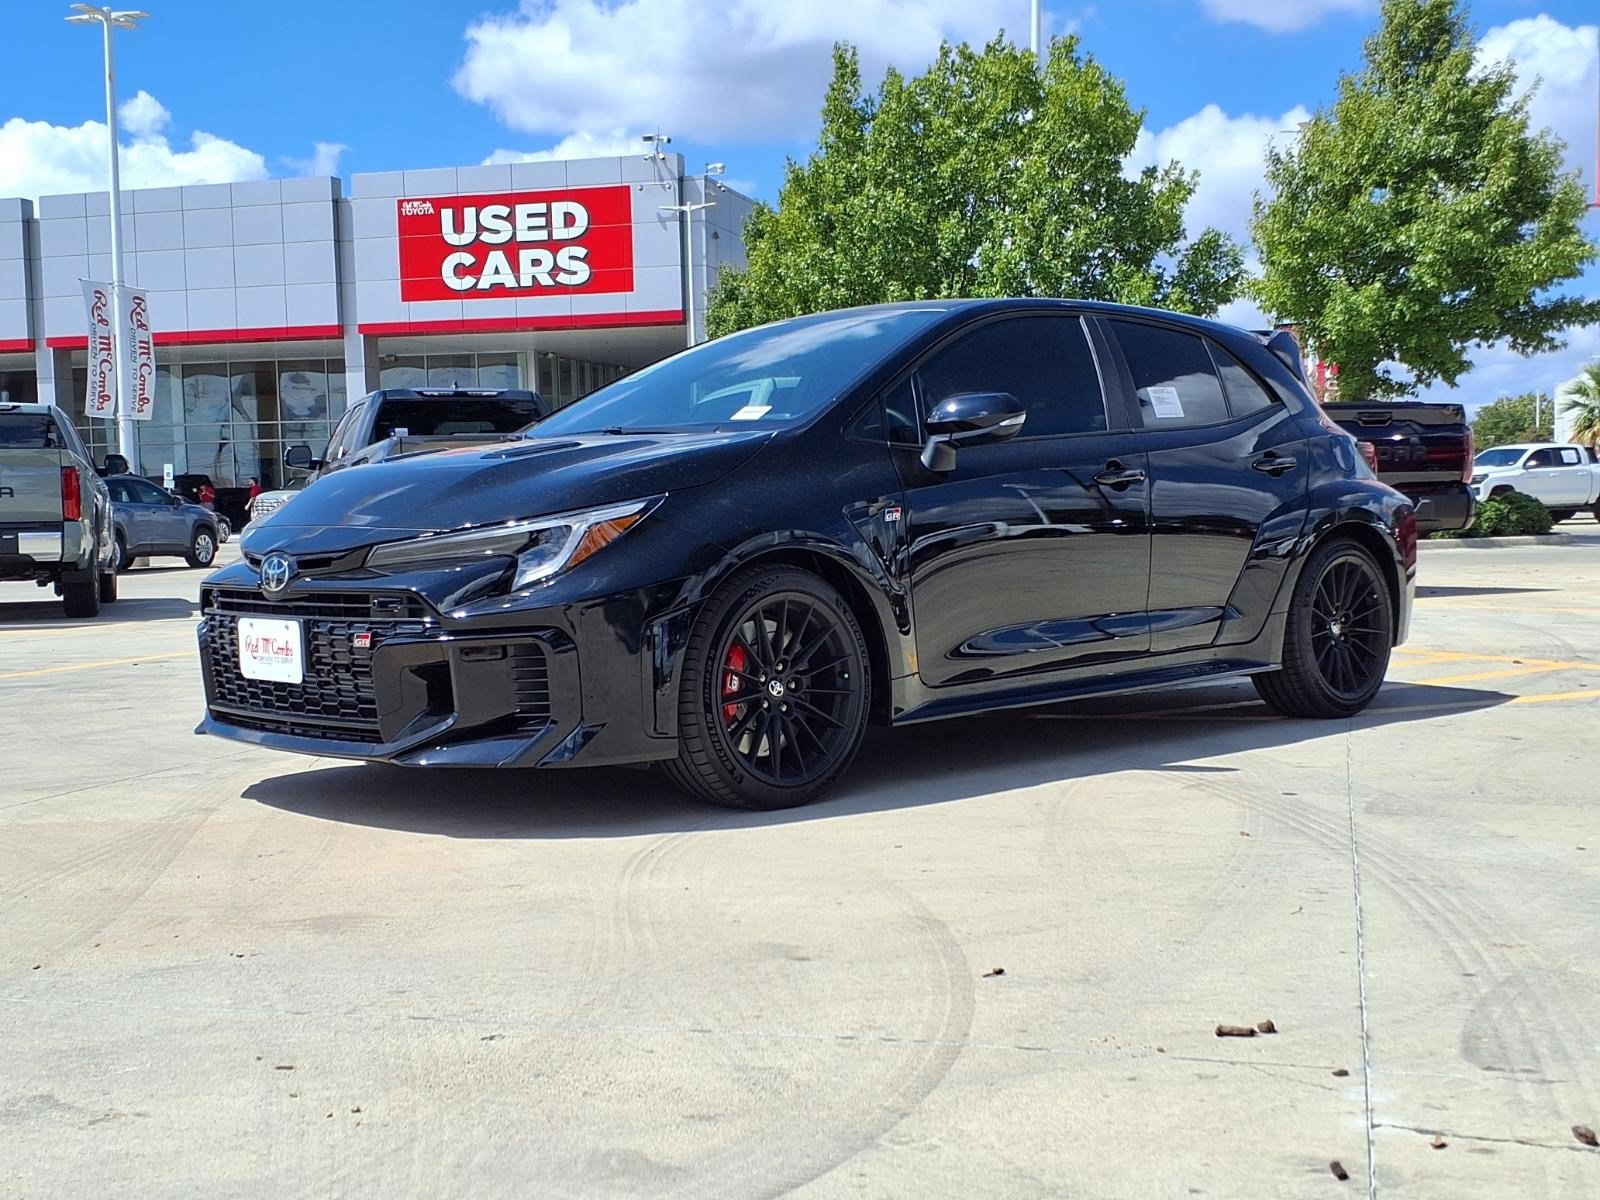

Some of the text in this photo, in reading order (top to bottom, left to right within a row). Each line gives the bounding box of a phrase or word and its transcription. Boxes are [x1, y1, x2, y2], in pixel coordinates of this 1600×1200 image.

[400, 207, 435, 216] TOYOTA
[440, 201, 589, 247] USED
[441, 246, 591, 291] CARS
[91, 289, 113, 412] Red McCombs
[130, 295, 152, 414] Red McCombs
[91, 364, 98, 377] TO
[131, 367, 138, 380] TO
[90, 381, 98, 411] SERVE
[130, 383, 138, 412] SERVE
[885, 513, 900, 521] GR
[245, 635, 259, 659] Red
